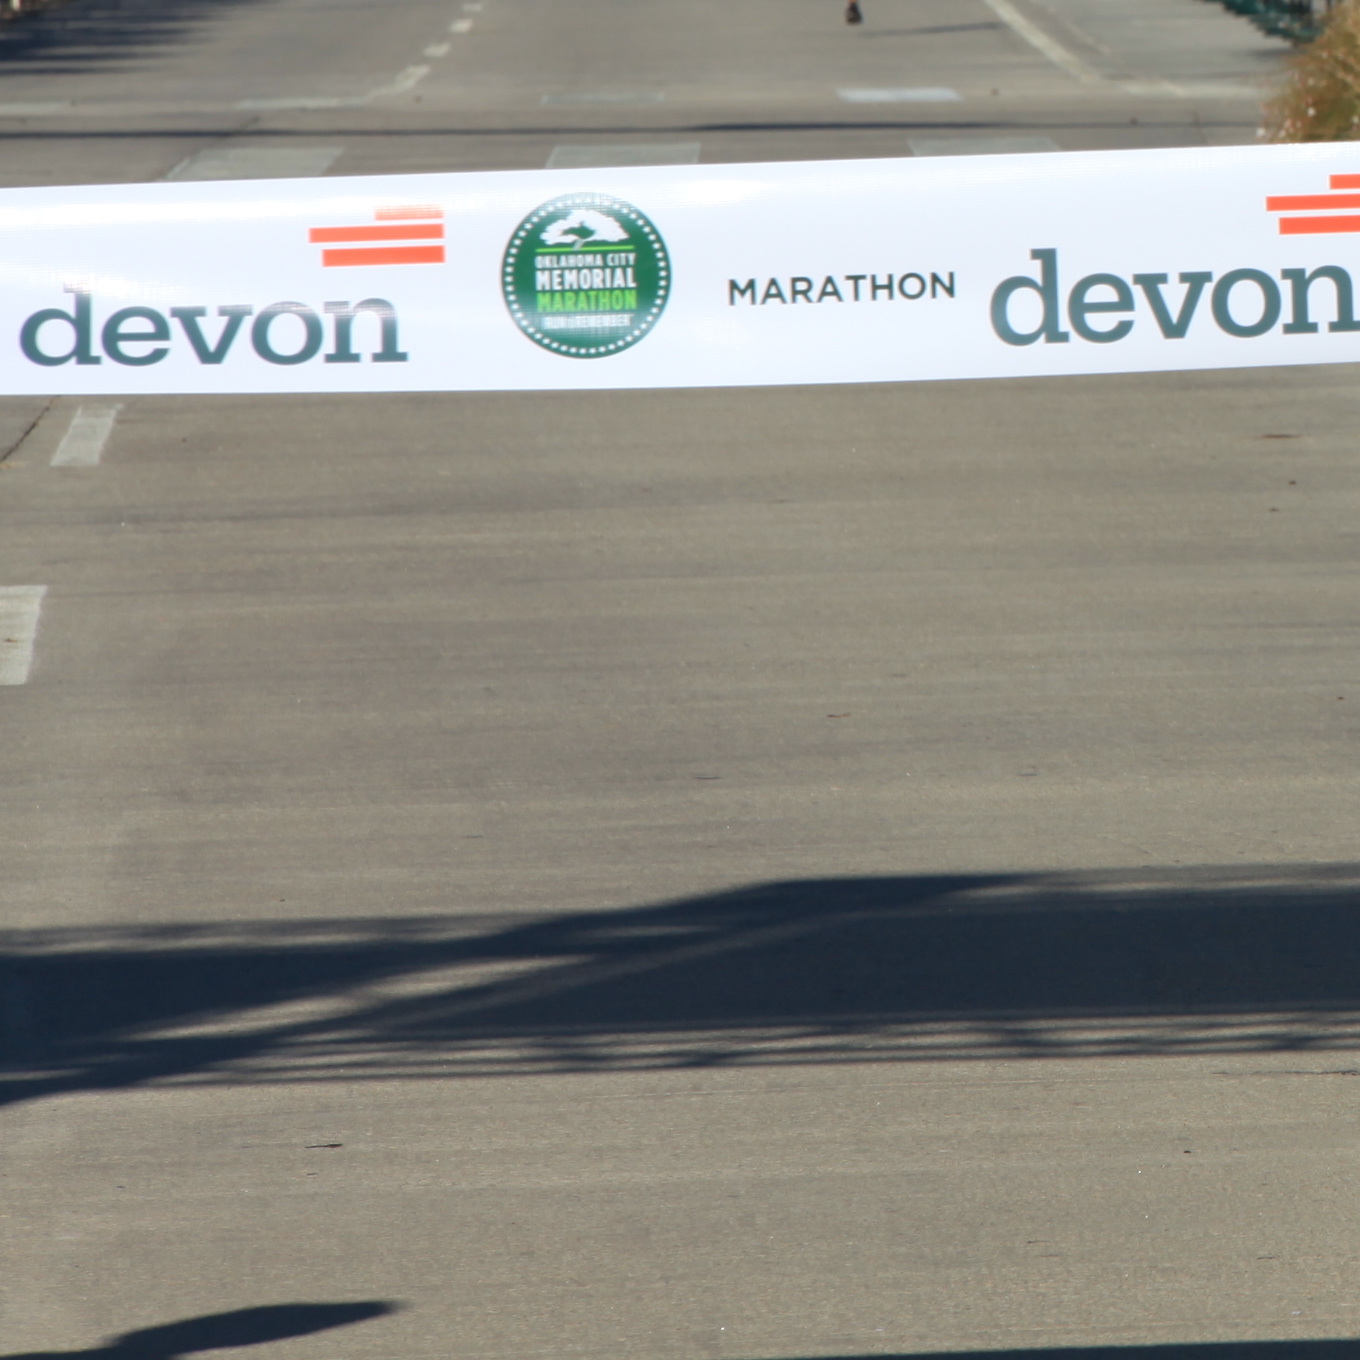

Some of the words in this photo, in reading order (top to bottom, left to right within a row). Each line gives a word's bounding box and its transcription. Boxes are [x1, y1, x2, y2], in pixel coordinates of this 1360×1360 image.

[535, 253, 603, 269] OKLAHOMA
[607, 252, 637, 266] CITY
[535, 267, 638, 291] MEMORIAL
[728, 271, 956, 306] MARATHON
[536, 289, 638, 313] MARATHON
[19, 292, 409, 368] devon
